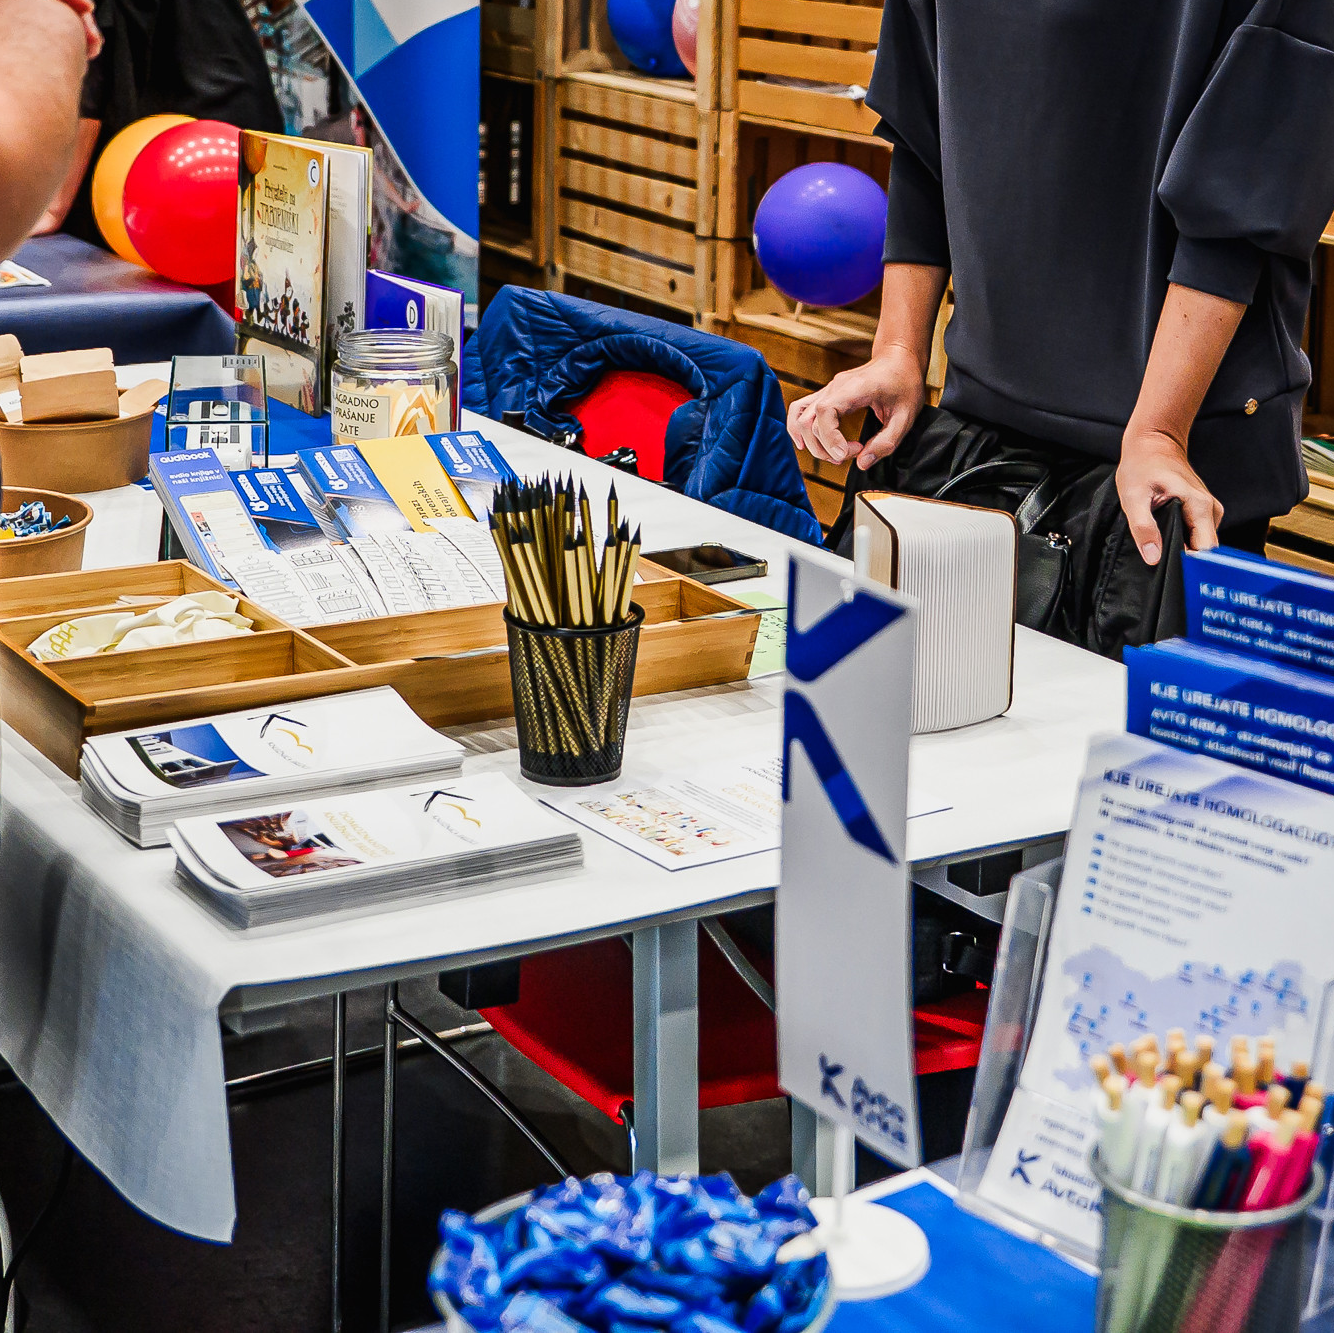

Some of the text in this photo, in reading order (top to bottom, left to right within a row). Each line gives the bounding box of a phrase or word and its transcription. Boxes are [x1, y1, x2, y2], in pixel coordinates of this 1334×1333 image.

[409, 306, 416, 324] D
[334, 393, 379, 409] AGRADNO
[334, 406, 376, 424] PRAŠANJE
[339, 422, 359, 436] ZATE
[159, 451, 212, 464] audibook
[1199, 582, 1226, 600] KJE
[1229, 588, 1293, 617] UREJATE
[1150, 681, 1178, 700] KJE
[1182, 688, 1250, 718] UREJATE
[1103, 769, 1131, 787] KJE
[1135, 776, 1201, 806] UREJATE
